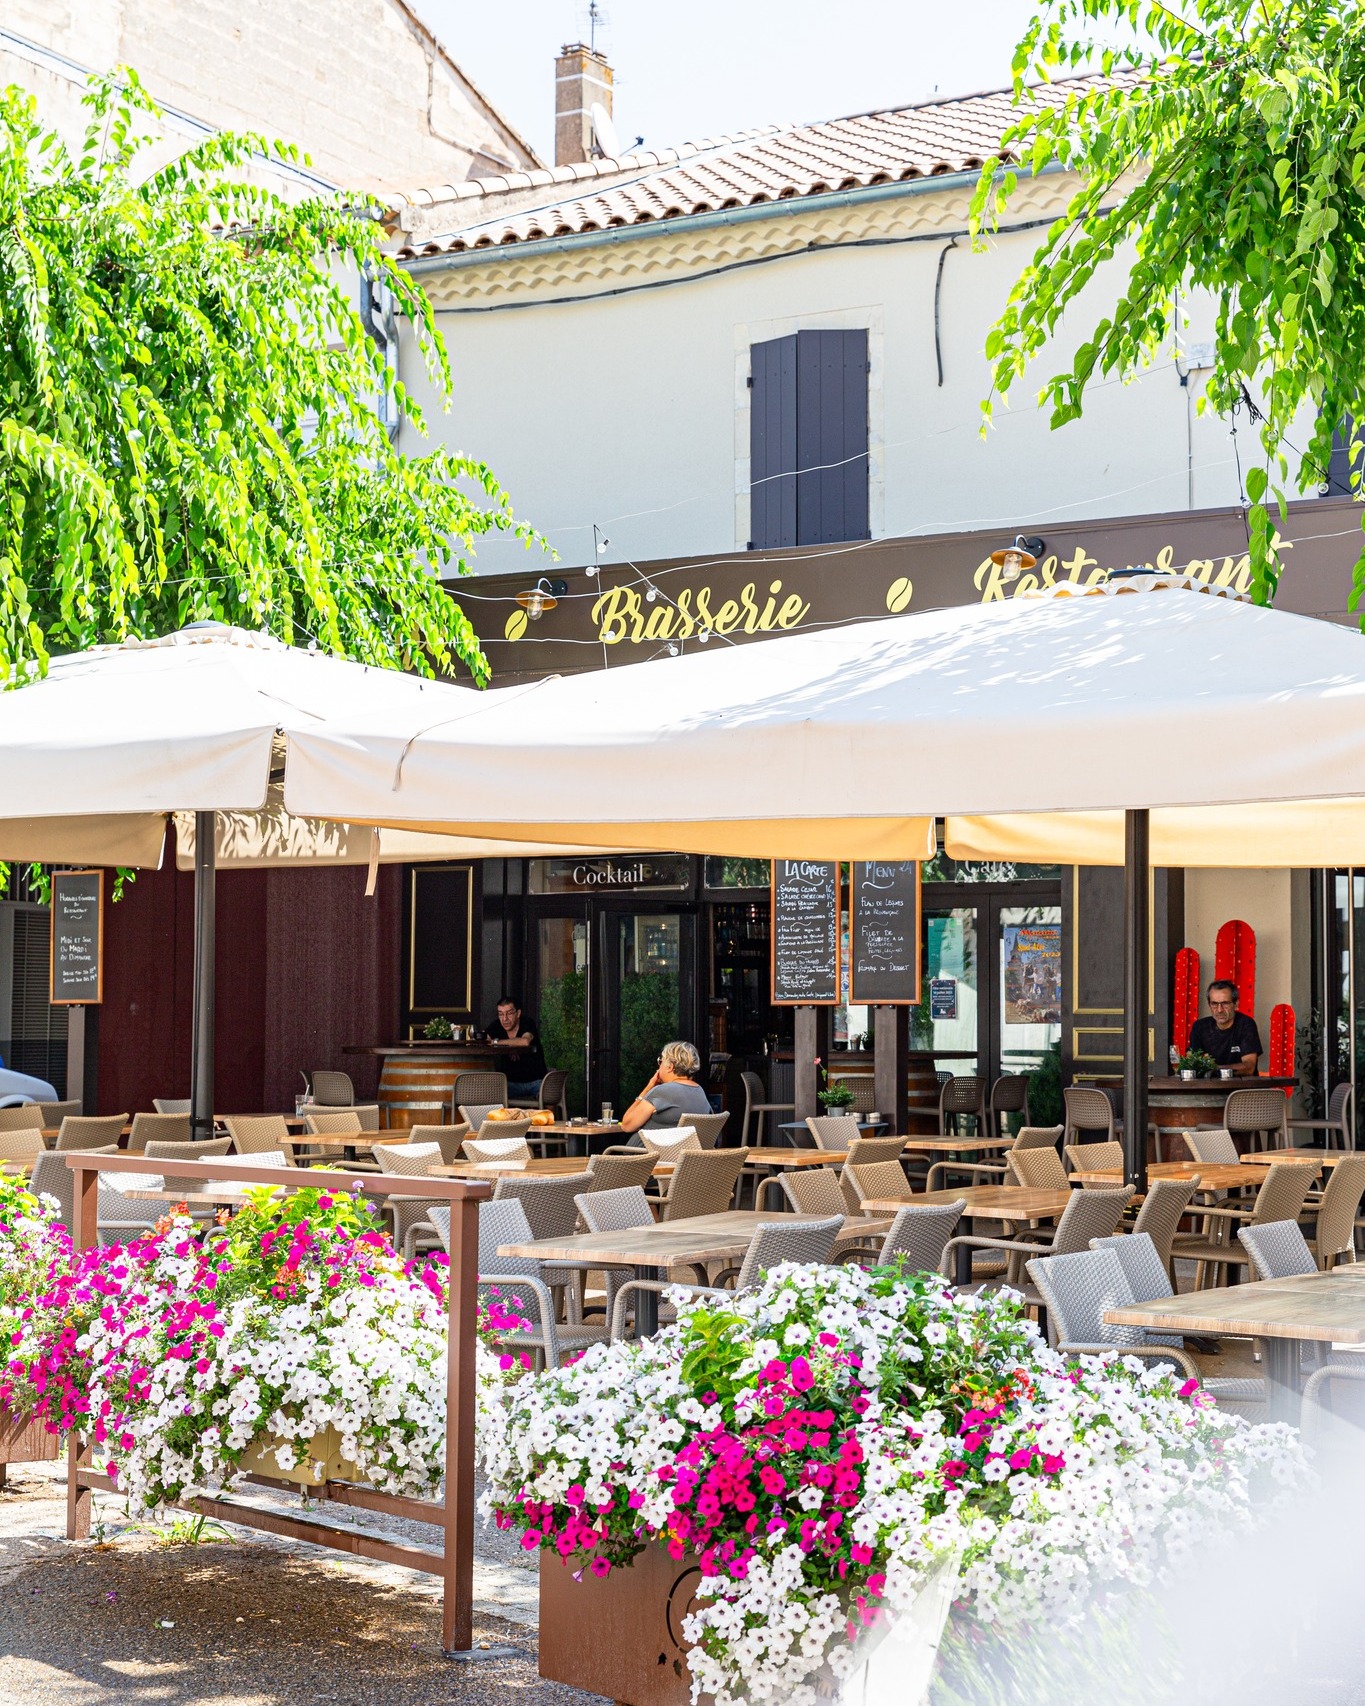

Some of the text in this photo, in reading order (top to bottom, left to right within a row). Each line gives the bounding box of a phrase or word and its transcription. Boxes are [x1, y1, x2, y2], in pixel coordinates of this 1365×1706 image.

[591, 580, 811, 645] Brasserie
[573, 863, 644, 885] Cocktail
[785, 860, 828, 879] LA CARTE
[866, 861, 896, 884] MENU
